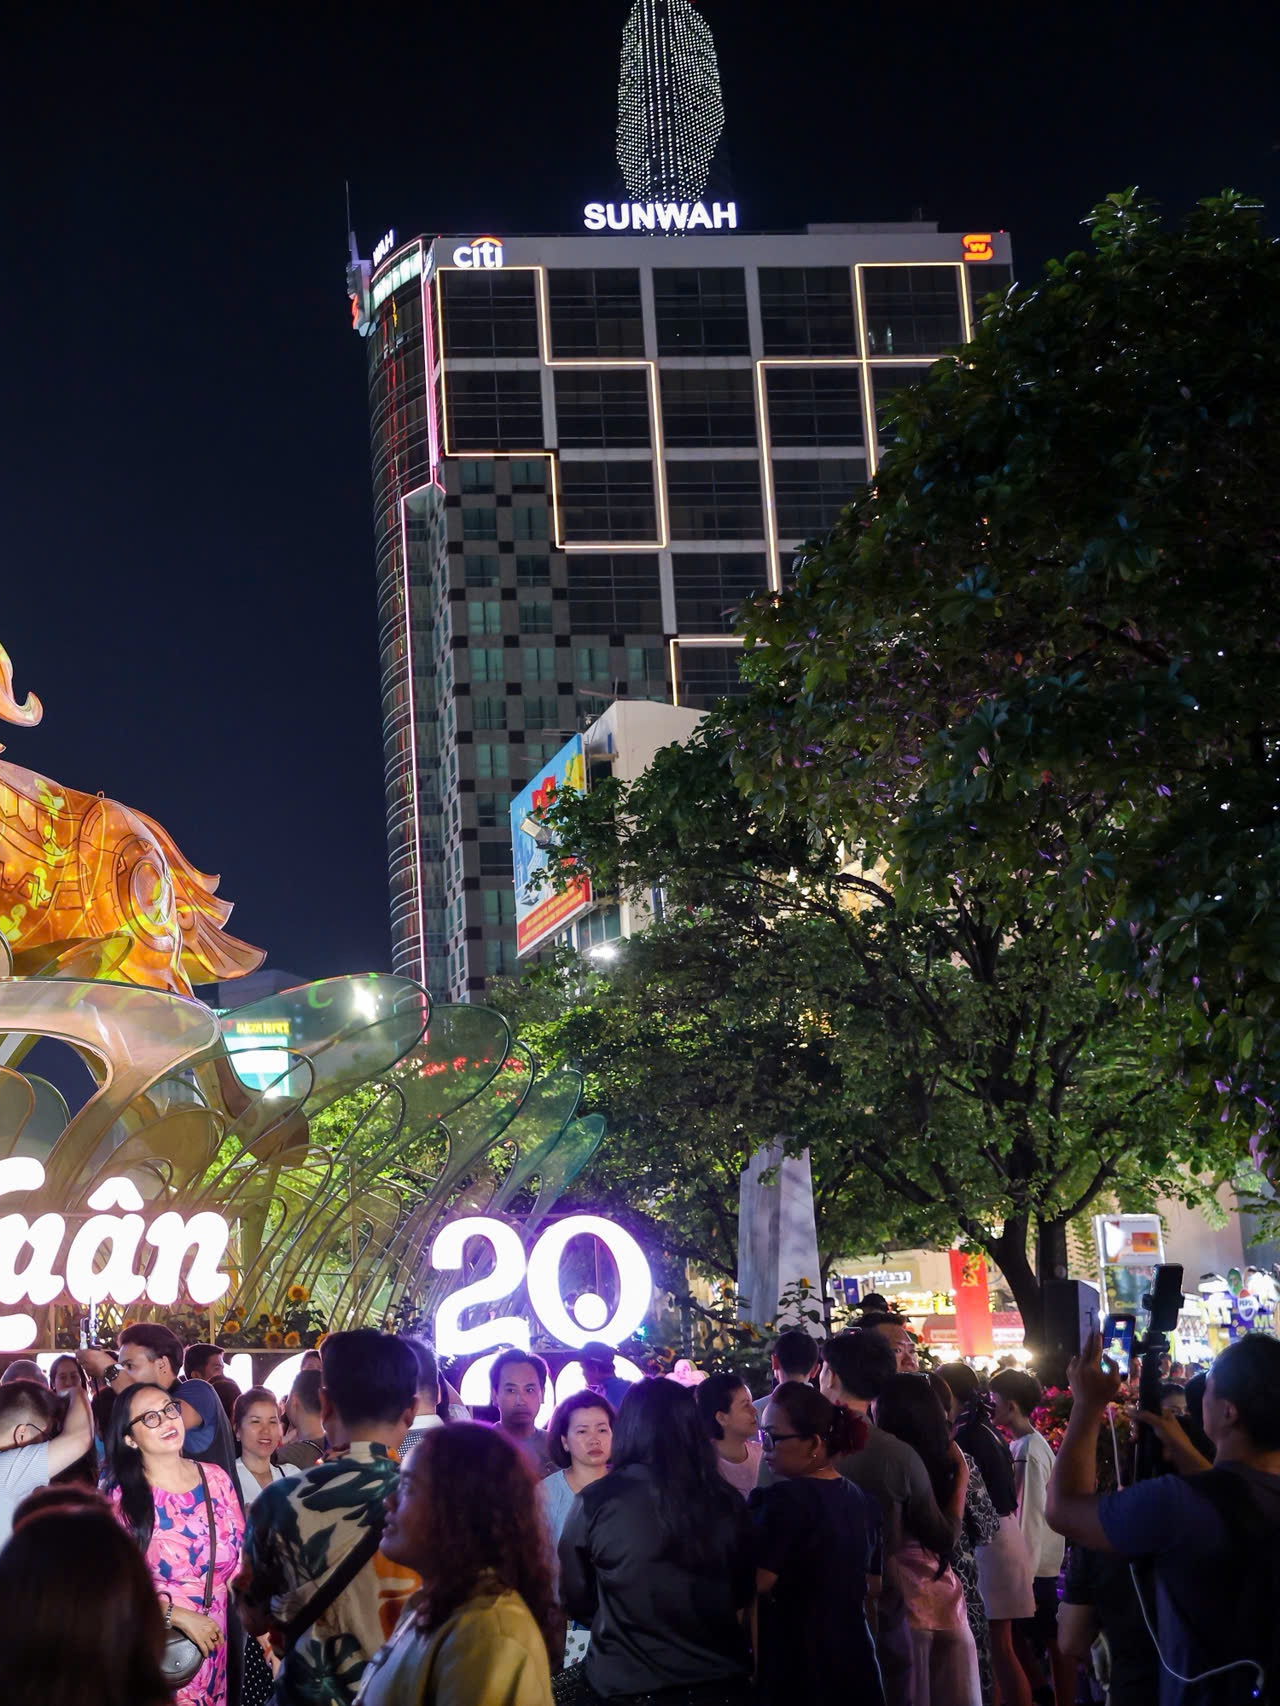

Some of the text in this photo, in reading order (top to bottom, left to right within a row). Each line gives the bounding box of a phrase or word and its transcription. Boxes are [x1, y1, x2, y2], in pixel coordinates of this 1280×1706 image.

[583, 201, 738, 230] SUNWAH
[453, 237, 503, 268] citi
[431, 1214, 653, 1356] 20
